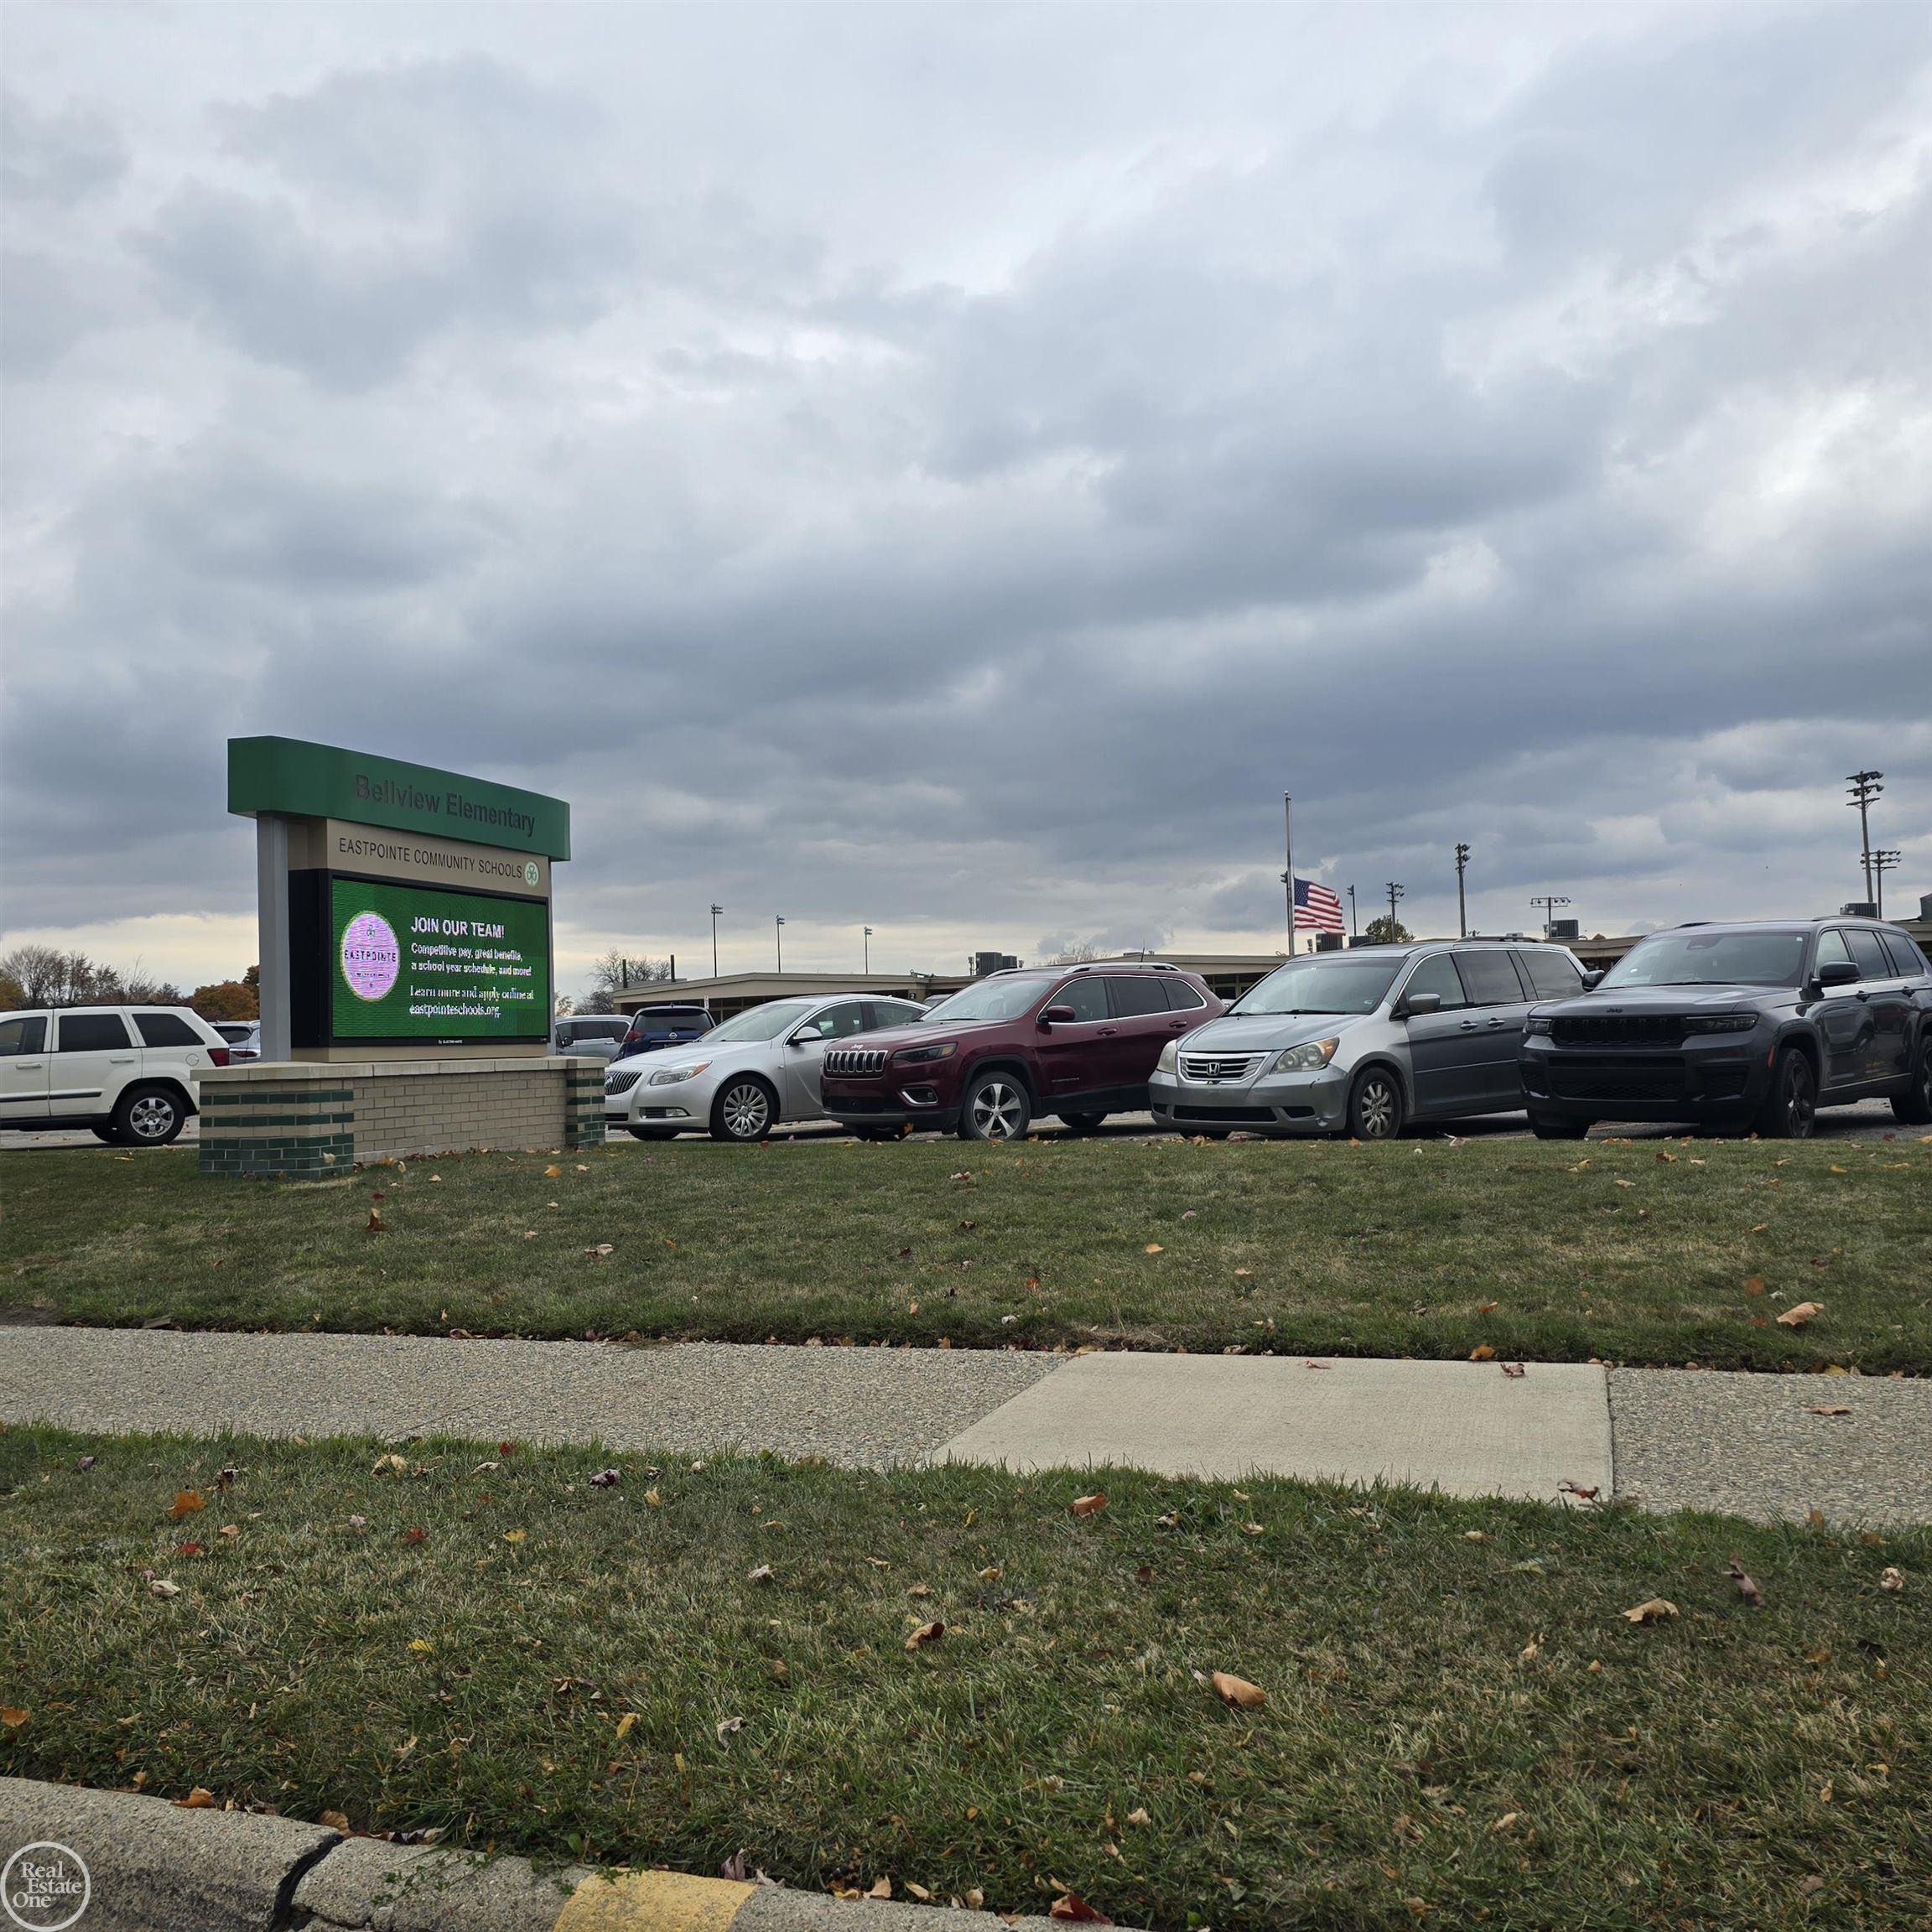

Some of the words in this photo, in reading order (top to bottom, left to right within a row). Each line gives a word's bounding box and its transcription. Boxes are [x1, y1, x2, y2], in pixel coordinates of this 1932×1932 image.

[355, 774, 441, 813] Bellview
[446, 792, 535, 838] Elementary
[339, 838, 410, 862] EASTPOINTE
[413, 849, 475, 872] COMMUNITY
[478, 860, 522, 879] SCHOOLS
[411, 917, 439, 933] JOIN
[442, 919, 468, 936] OUR
[470, 922, 505, 938] TEAM!
[344, 949, 397, 962] EASTPOINTE
[411, 942, 457, 957] Competitive
[411, 962, 418, 970] a
[418, 959, 445, 972] school
[445, 963, 463, 974] year
[498, 964, 512, 975] and
[410, 984, 436, 997] Learn
[461, 985, 477, 999] and
